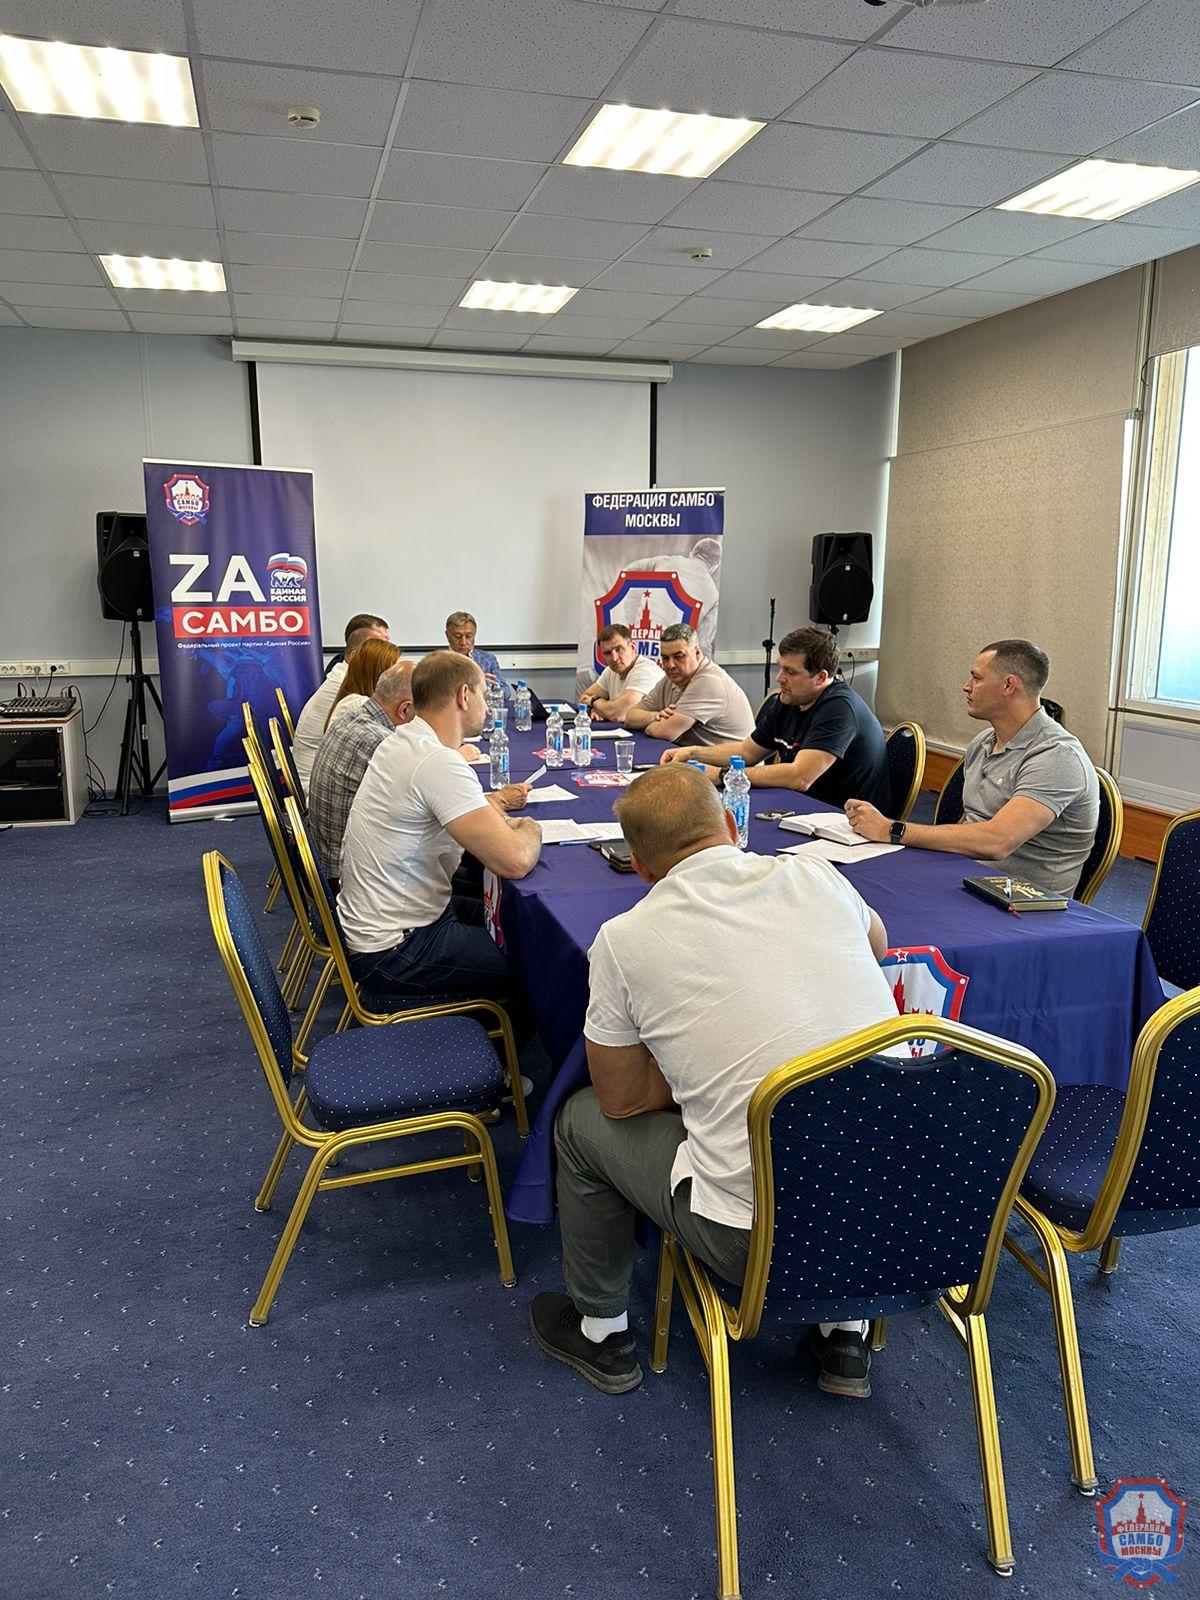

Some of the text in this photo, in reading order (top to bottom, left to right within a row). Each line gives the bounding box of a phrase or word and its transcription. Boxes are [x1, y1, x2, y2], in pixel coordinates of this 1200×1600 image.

[592, 492, 715, 510] ФЕДЕРАЦИЯ САМБО
[625, 513, 681, 528] МОСКВЫ
[182, 610, 304, 634] САМБО
[631, 629, 661, 639] ДЕРАЦ
